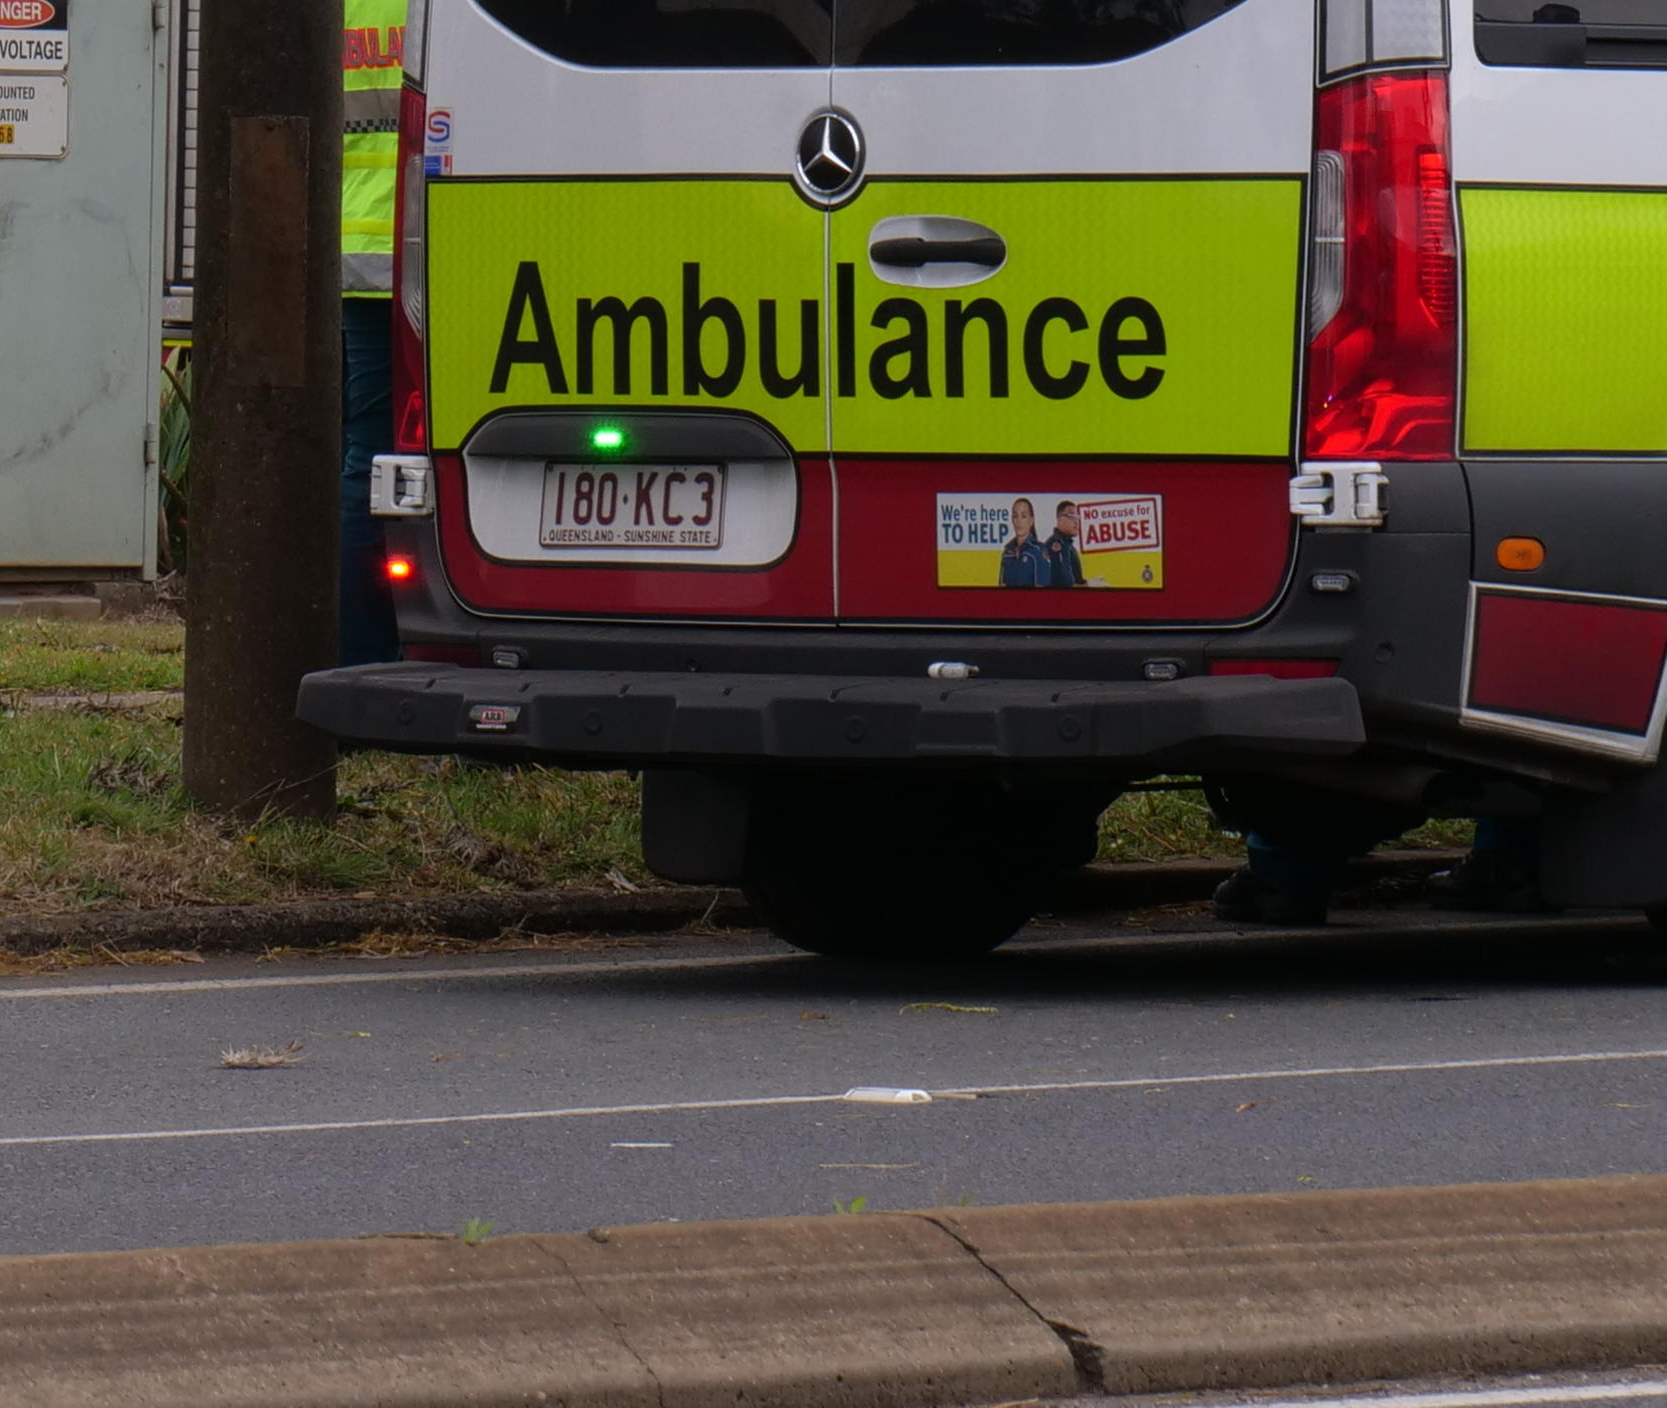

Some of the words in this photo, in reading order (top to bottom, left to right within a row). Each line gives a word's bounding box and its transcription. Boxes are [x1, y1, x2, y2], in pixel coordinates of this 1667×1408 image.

[0, 40, 63, 60] VOLTAGE
[343, 26, 406, 70] BULA
[489, 261, 1168, 400] Ambulance
[941, 504, 978, 522] We're
[980, 505, 1009, 522] here
[1083, 508, 1099, 520] NO
[1101, 508, 1135, 519] excuse
[1136, 504, 1151, 517] for
[548, 529, 614, 542] QUEENSLAND
[624, 530, 675, 542] SUNSHINE
[679, 531, 711, 543] STATE
[942, 523, 963, 544] TO
[968, 523, 1010, 544] HELP
[1086, 519, 1152, 545] ABUSE
